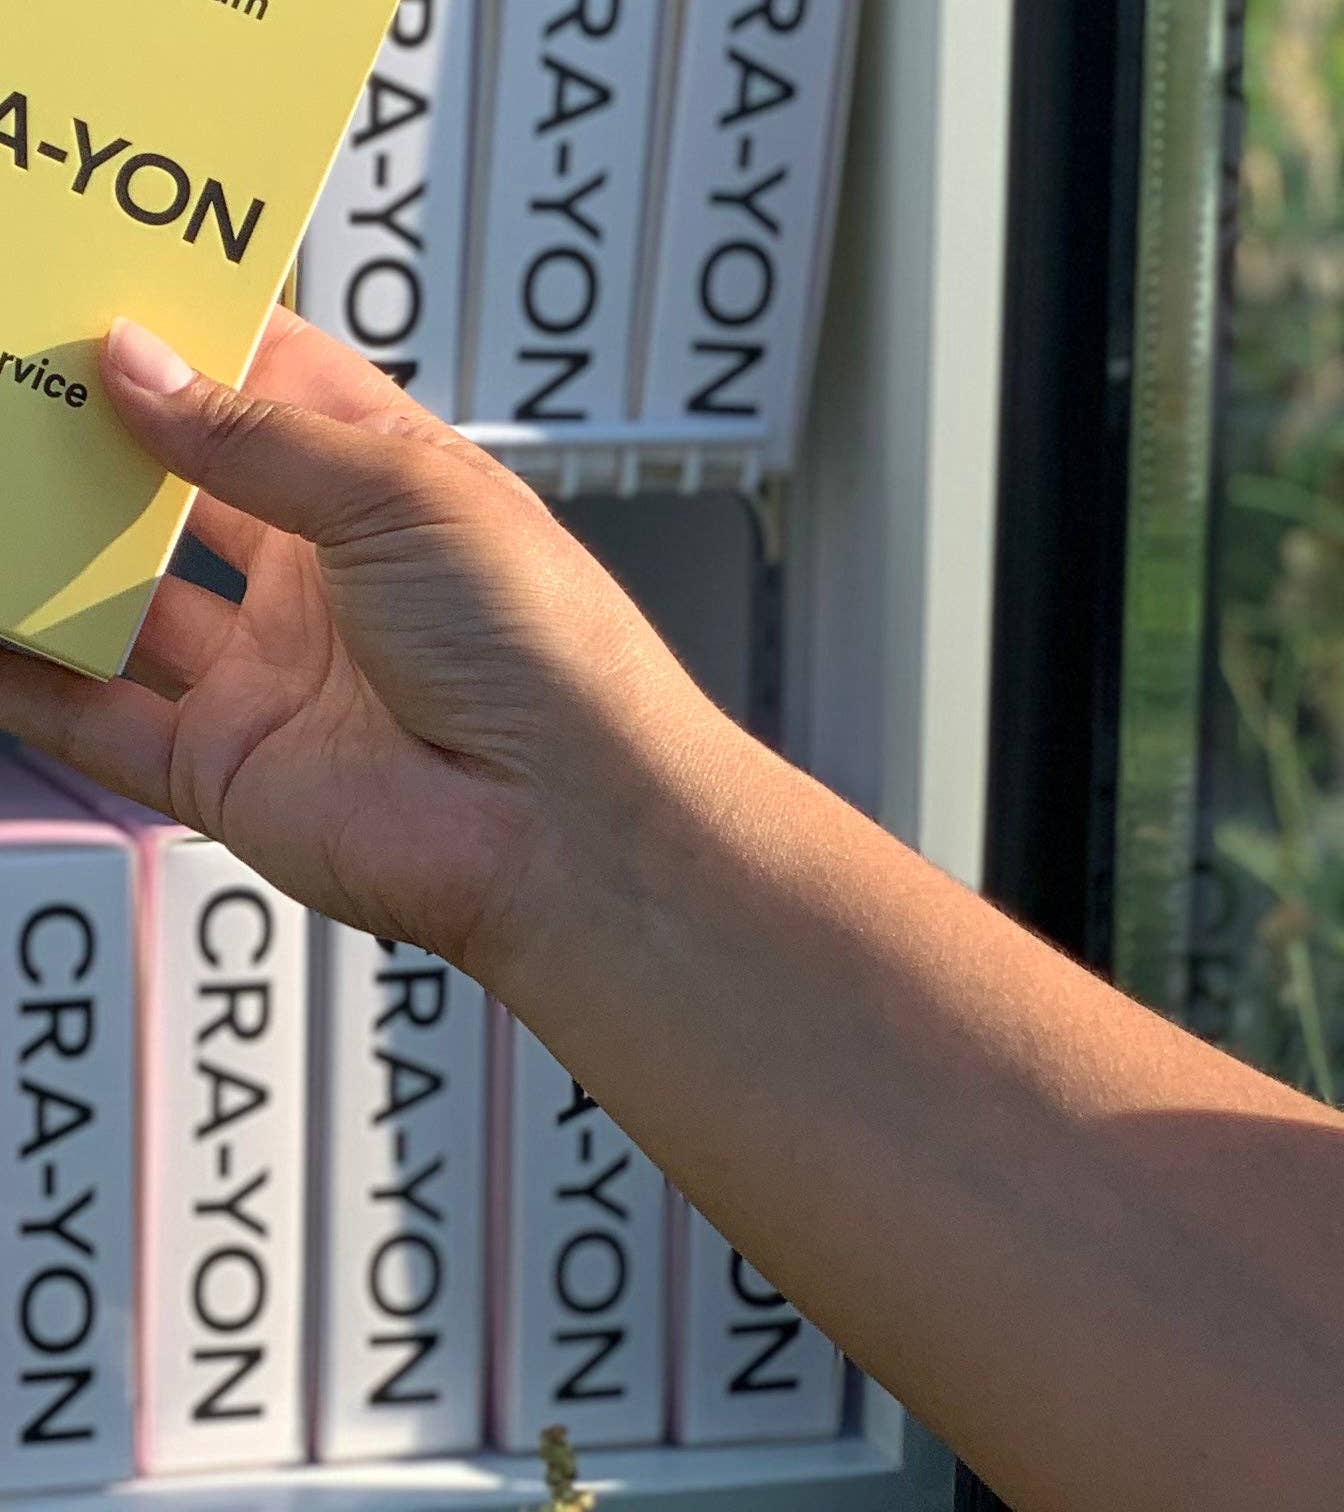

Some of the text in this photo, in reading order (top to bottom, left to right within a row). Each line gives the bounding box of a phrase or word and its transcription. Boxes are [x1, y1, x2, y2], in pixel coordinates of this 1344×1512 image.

[18, 904, 97, 1446] CRA-YON
[191, 887, 274, 1424] CRA-YON
[369, 937, 447, 1408] RA-YON
